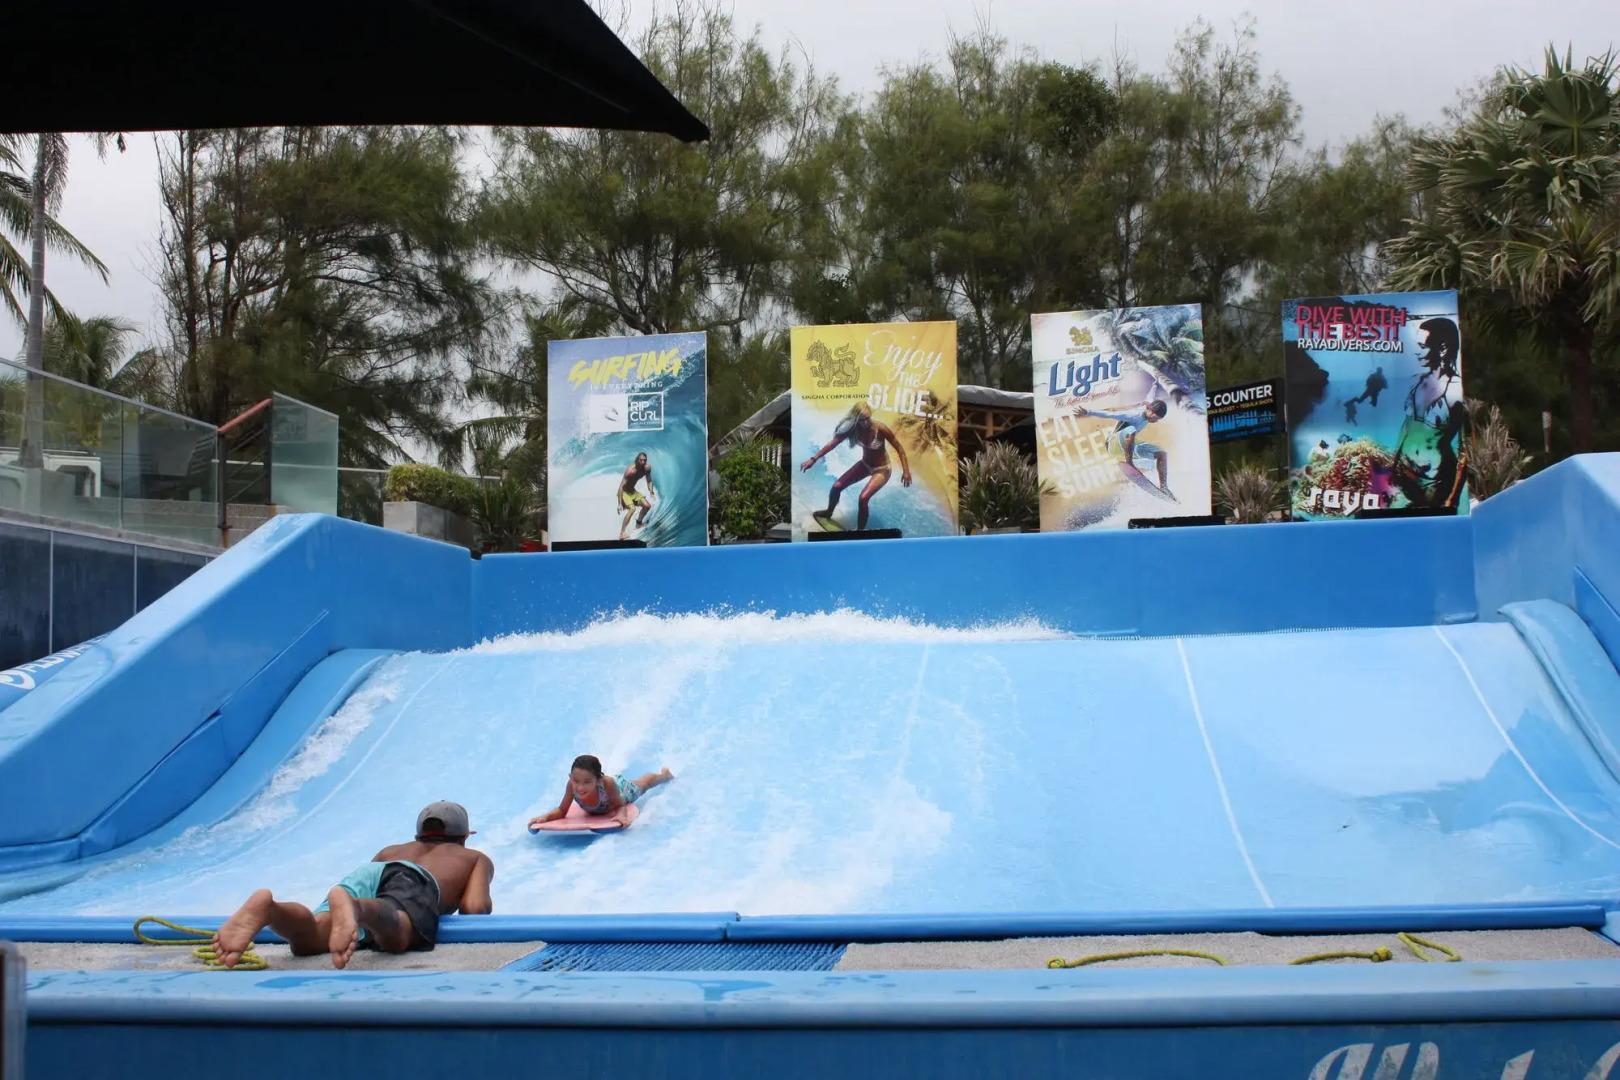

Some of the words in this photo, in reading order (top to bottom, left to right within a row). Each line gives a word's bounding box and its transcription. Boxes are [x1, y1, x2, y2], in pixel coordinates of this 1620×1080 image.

[1295, 305, 1345, 325] DIVE
[1350, 306, 1407, 326] WITH
[1299, 322, 1338, 340] THE
[1342, 323, 1400, 341] BEST!
[863, 329, 943, 386] Enjoy
[1297, 337, 1403, 353] RAYADIVERS.COM
[567, 347, 682, 390] SURFING
[1048, 352, 1122, 397] Light
[630, 401, 650, 412] RIP
[1213, 384, 1273, 407] COUNTER
[630, 411, 660, 421] CURL
[1037, 414, 1082, 448] EAT
[1058, 456, 1122, 499] SURF
[1308, 488, 1381, 516] raya
